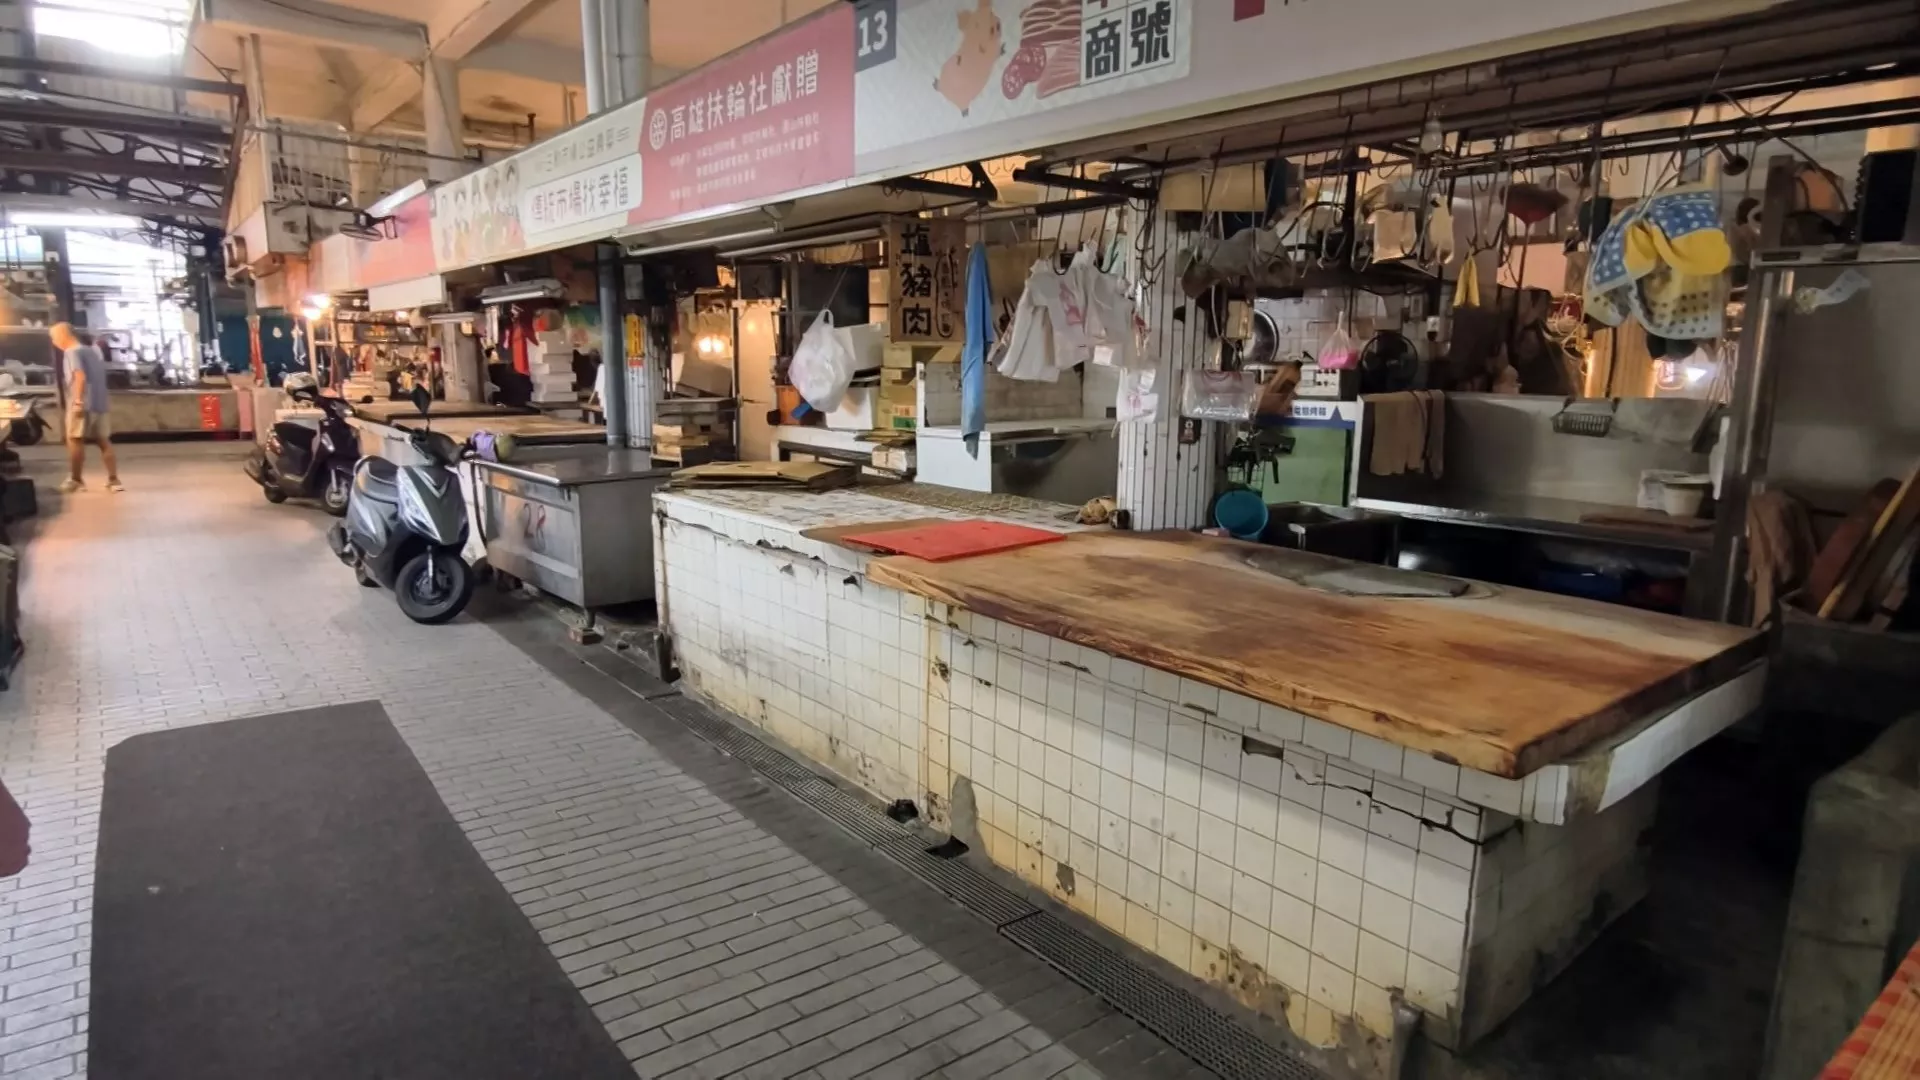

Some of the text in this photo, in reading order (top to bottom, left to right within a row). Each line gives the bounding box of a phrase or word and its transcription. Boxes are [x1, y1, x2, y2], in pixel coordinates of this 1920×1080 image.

[858, 9, 888, 57] 13
[1085, 1, 1171, 79] 商號
[670, 49, 819, 143] 高雄扶輪社獻贈
